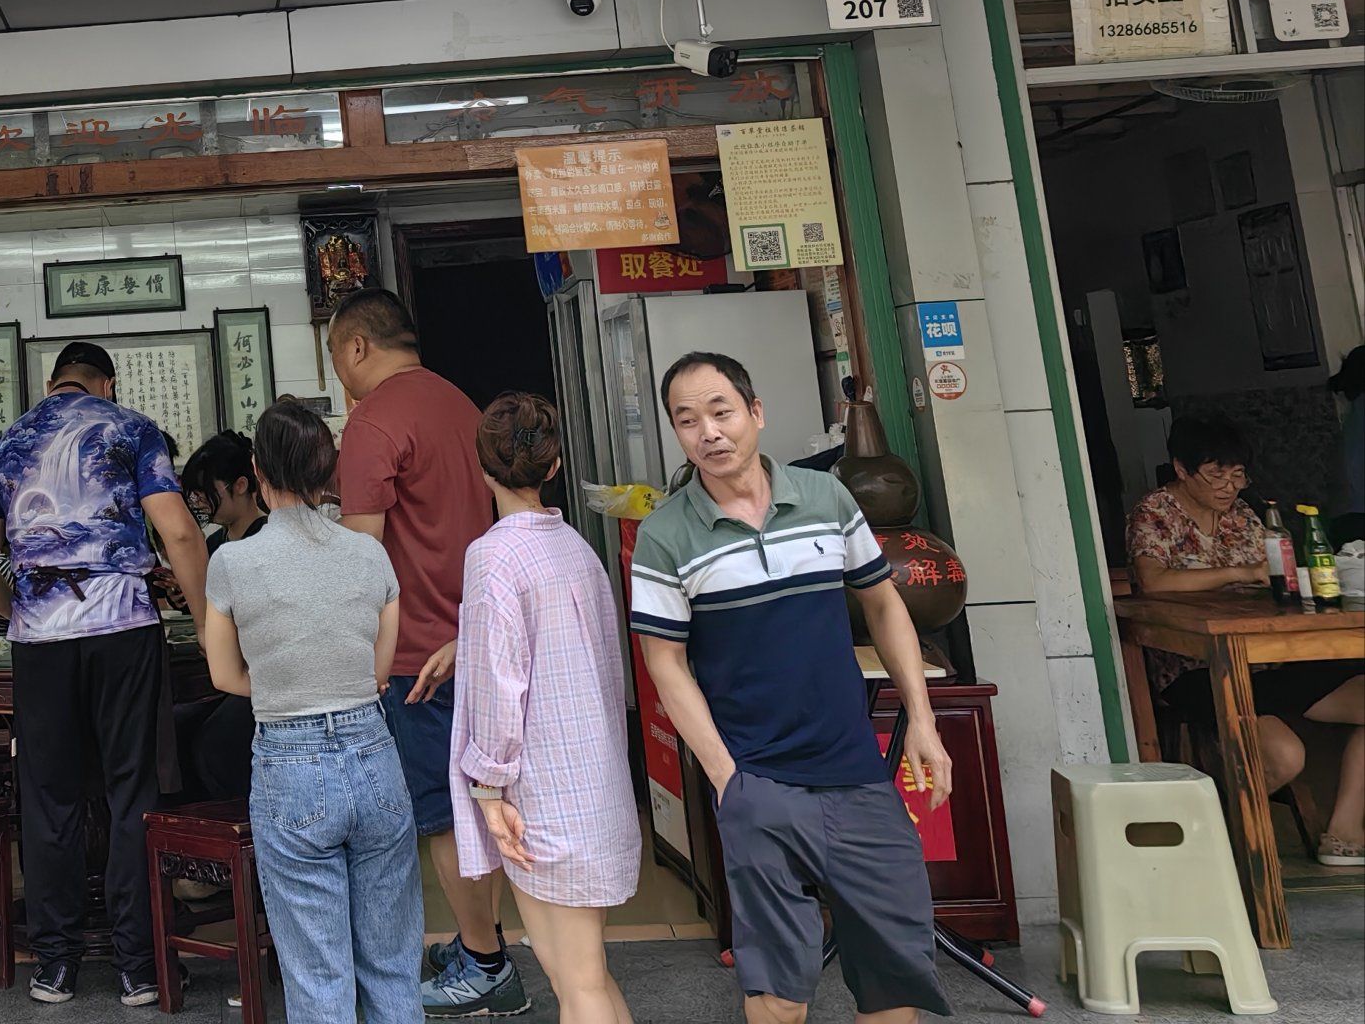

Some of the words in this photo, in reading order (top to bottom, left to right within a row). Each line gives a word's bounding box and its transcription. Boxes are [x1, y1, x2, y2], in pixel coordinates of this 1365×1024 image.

[1099, 20, 1197, 38] 13286685516
[620, 251, 704, 280] 取餐处
[926, 322, 957, 338] 花呗
[891, 558, 966, 587] 解毒
